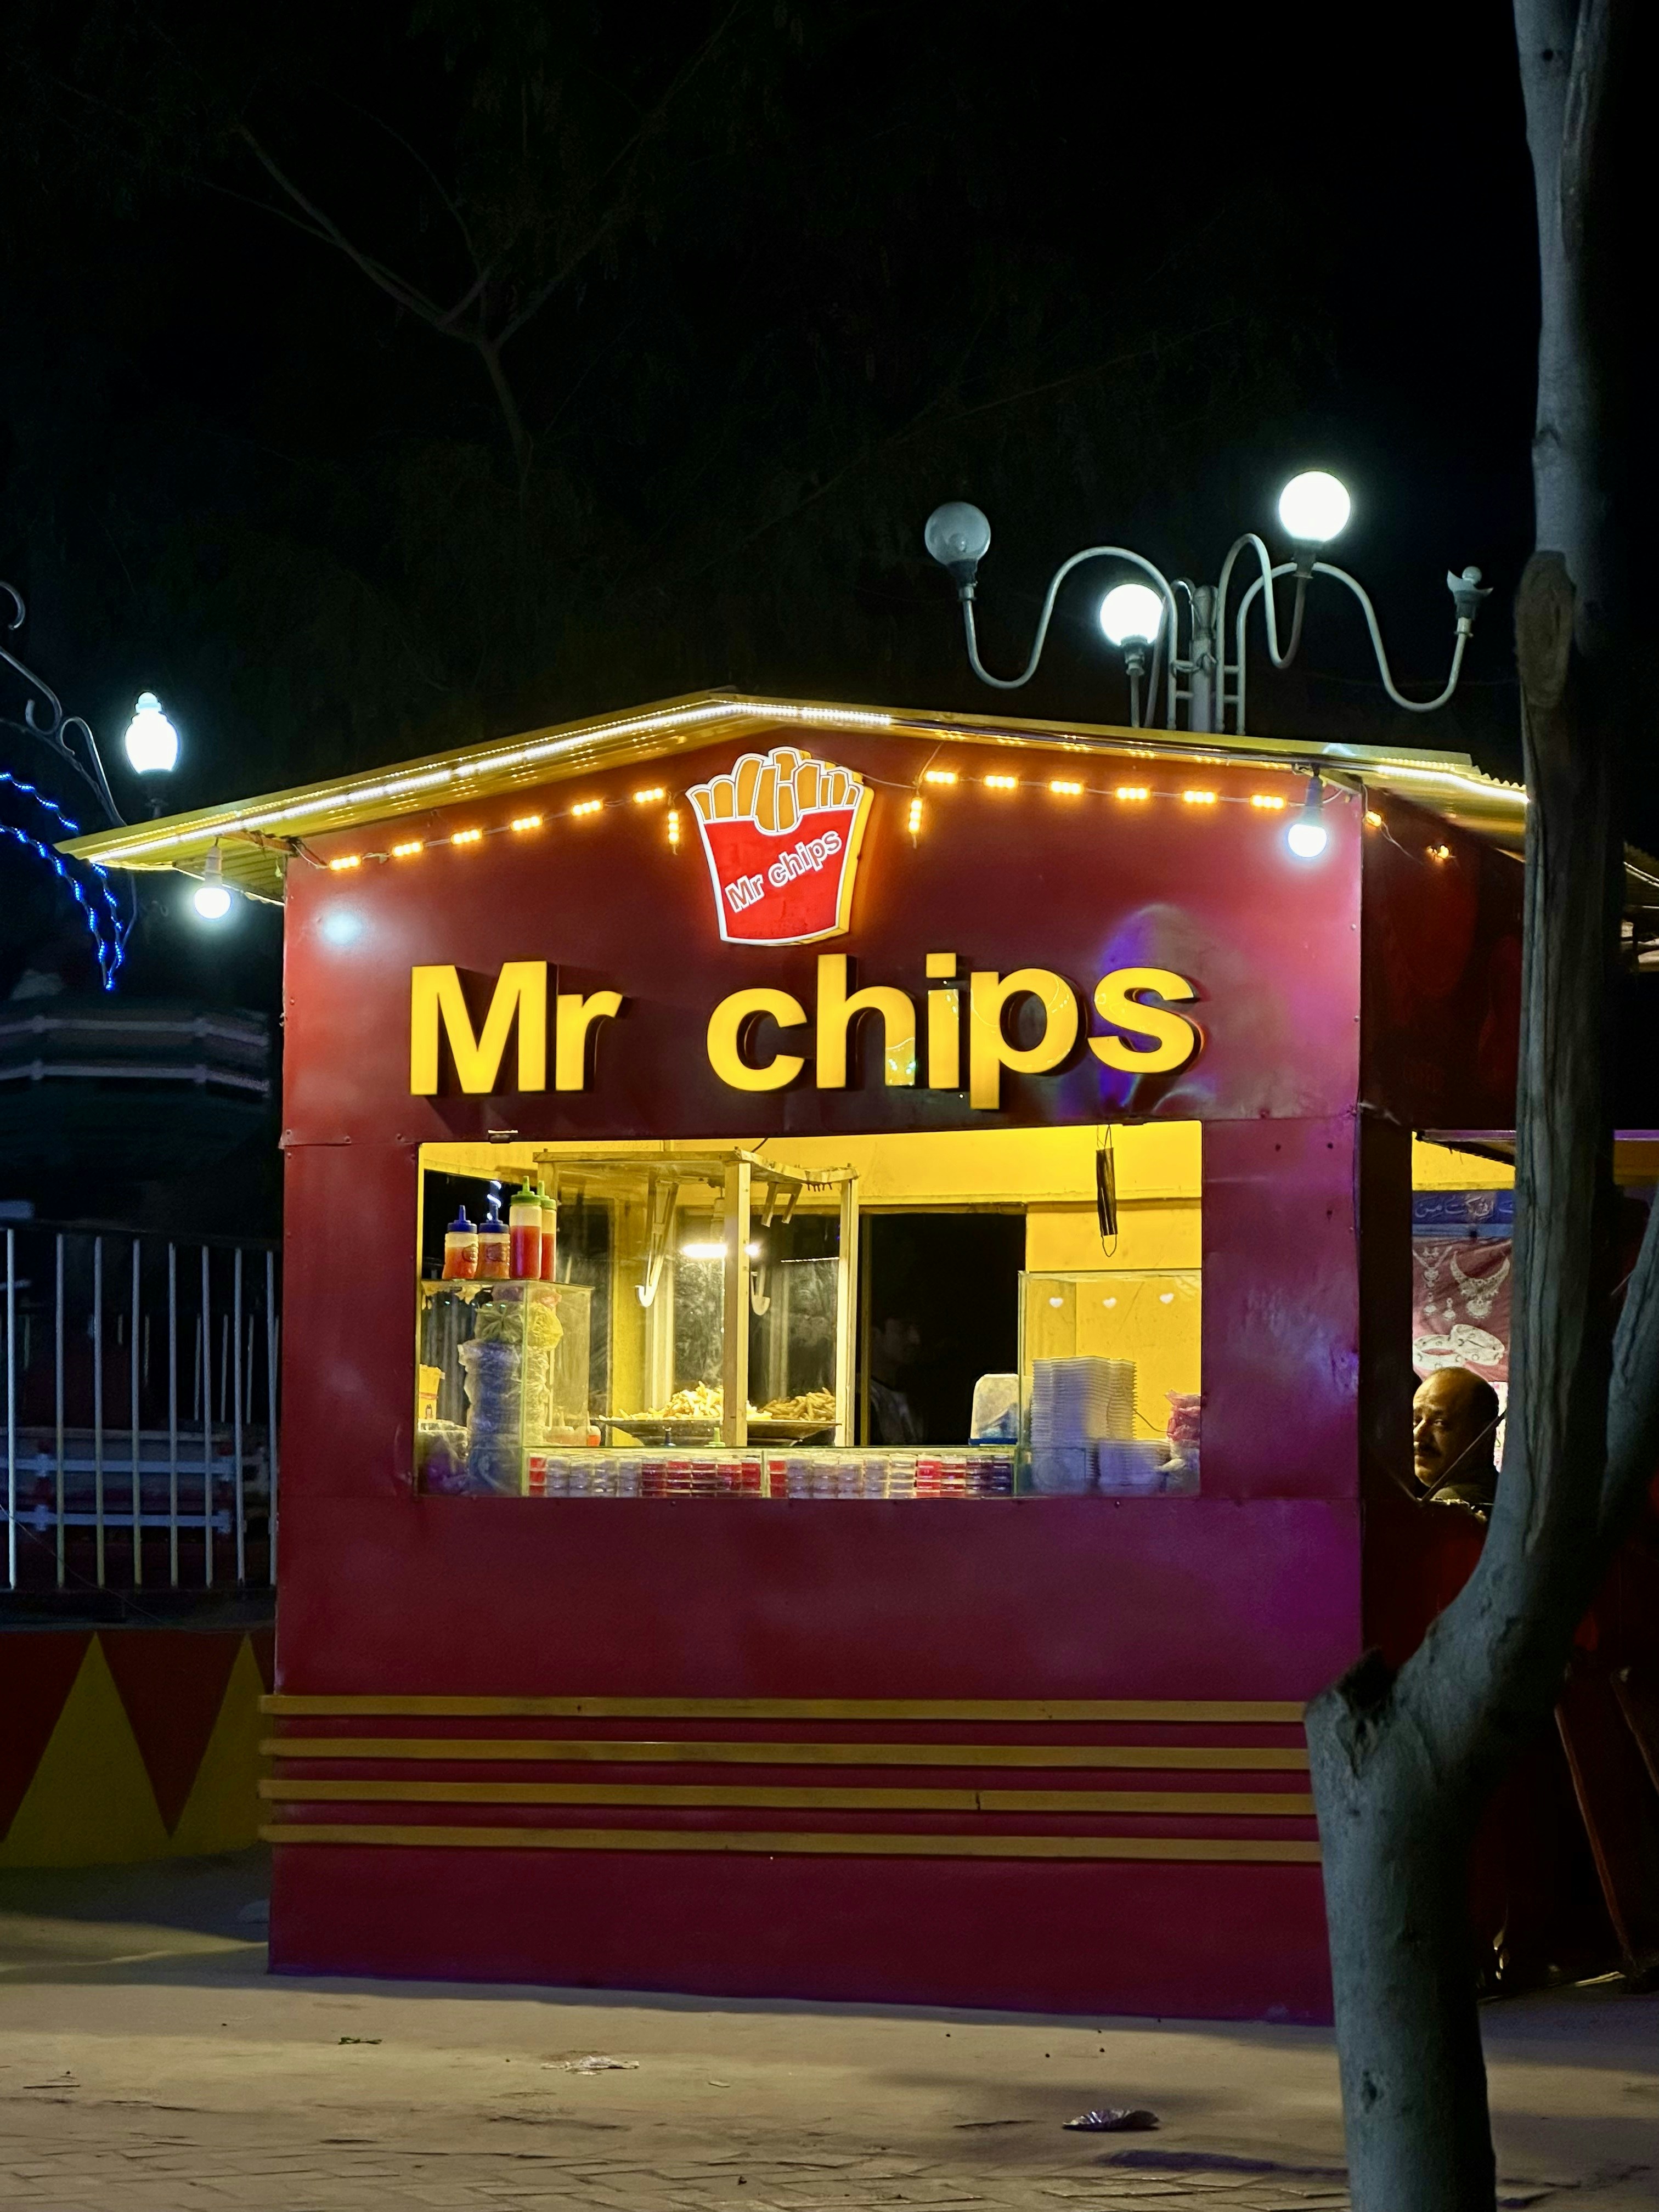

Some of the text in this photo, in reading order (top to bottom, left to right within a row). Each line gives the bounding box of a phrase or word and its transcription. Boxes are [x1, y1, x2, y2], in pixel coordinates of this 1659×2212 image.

[724, 831, 842, 913] Mr chips
[410, 952, 1196, 1110] Mr chips
